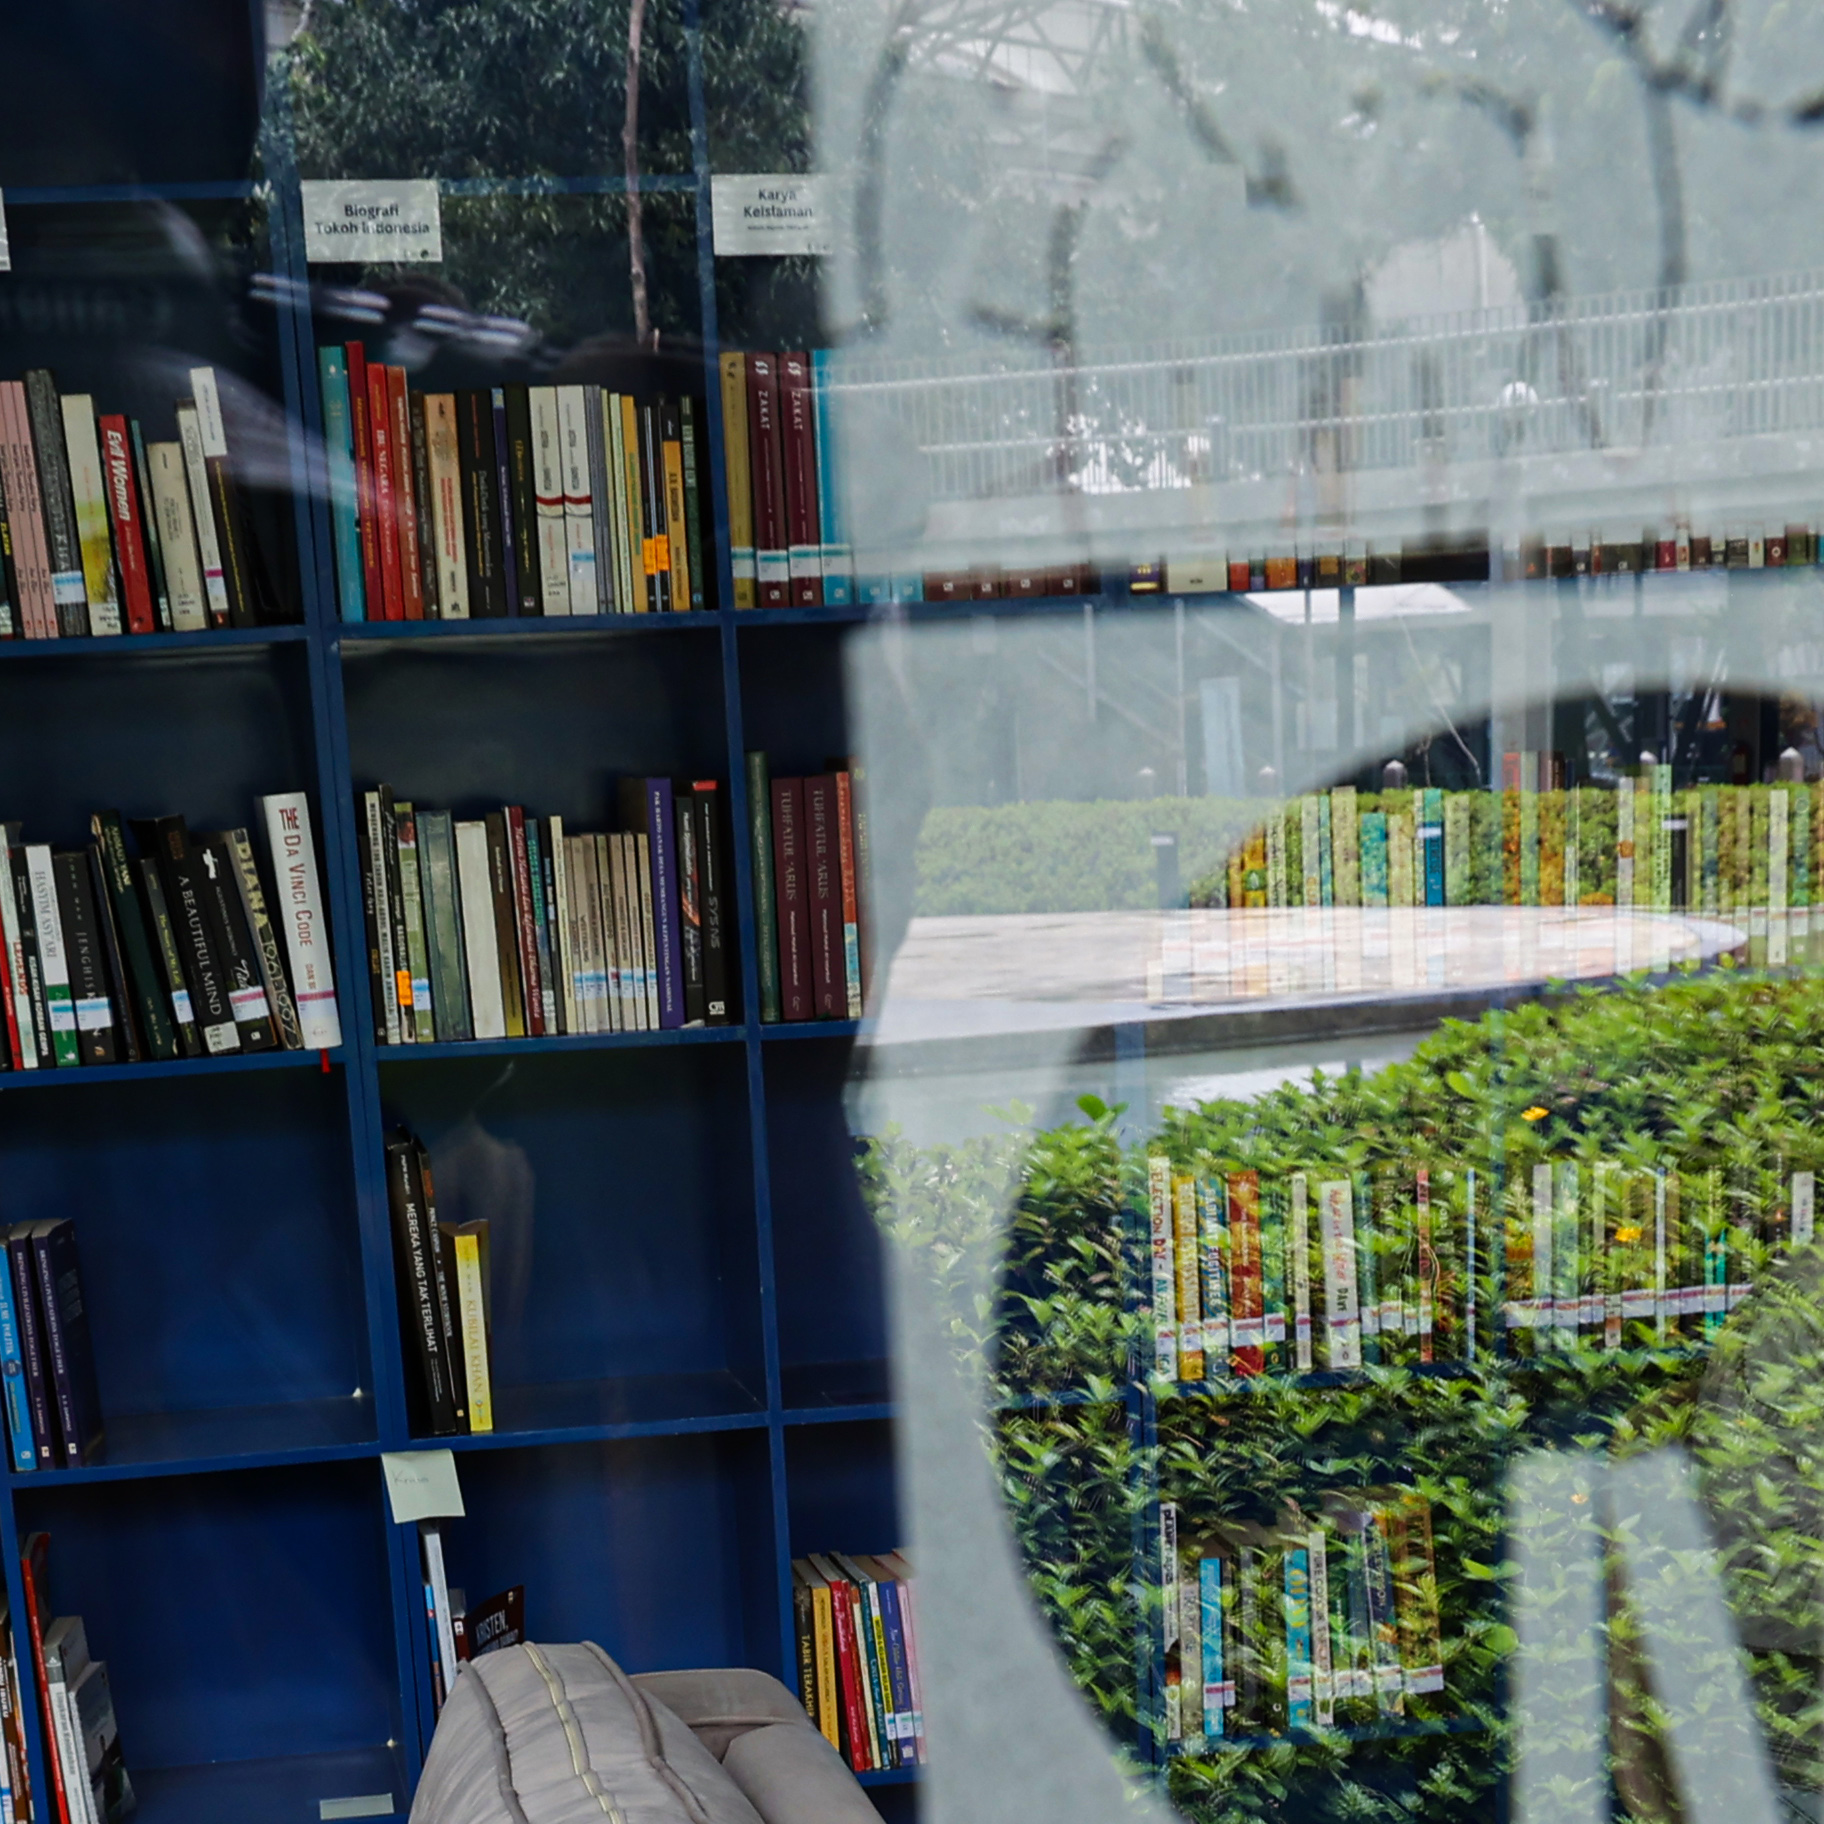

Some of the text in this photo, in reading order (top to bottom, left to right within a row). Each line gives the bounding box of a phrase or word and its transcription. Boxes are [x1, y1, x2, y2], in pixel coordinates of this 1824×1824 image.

[343, 204, 399, 220] Biografi
[758, 188, 797, 203] Karya
[315, 221, 430, 236] Tokoh Indonesia
[759, 390, 770, 429] ZAKAT
[791, 390, 802, 429] ZAKAT
[106, 429, 131, 521] Evil Women
[378, 449, 388, 493] NEGARA
[109, 824, 125, 861] AHMAD
[781, 790, 793, 858] TUHFATUL
[813, 788, 826, 857] TUHFATUL
[34, 870, 51, 914] HASYIM
[236, 840, 271, 928] DIANA
[279, 807, 316, 946] THE DA VINCI CODE
[158, 913, 168, 926] The
[161, 929, 172, 947] Story
[579, 914, 589, 962] WESTERLING
[707, 897, 720, 949] SYS NS
[181, 887, 210, 968] BEAUTIFUL
[200, 969, 222, 1016] MIND
[1153, 1238, 1166, 1259] DAY
[404, 1202, 438, 1353] MEREKA YANG TAK TERLIHAT
[27, 1335, 38, 1377] TOGETHER
[465, 1299, 483, 1393] KUBILAI KHAN
[1312, 1550, 1322, 1575] PURE
[800, 1635, 816, 1716] TABIR TERAKHIR
